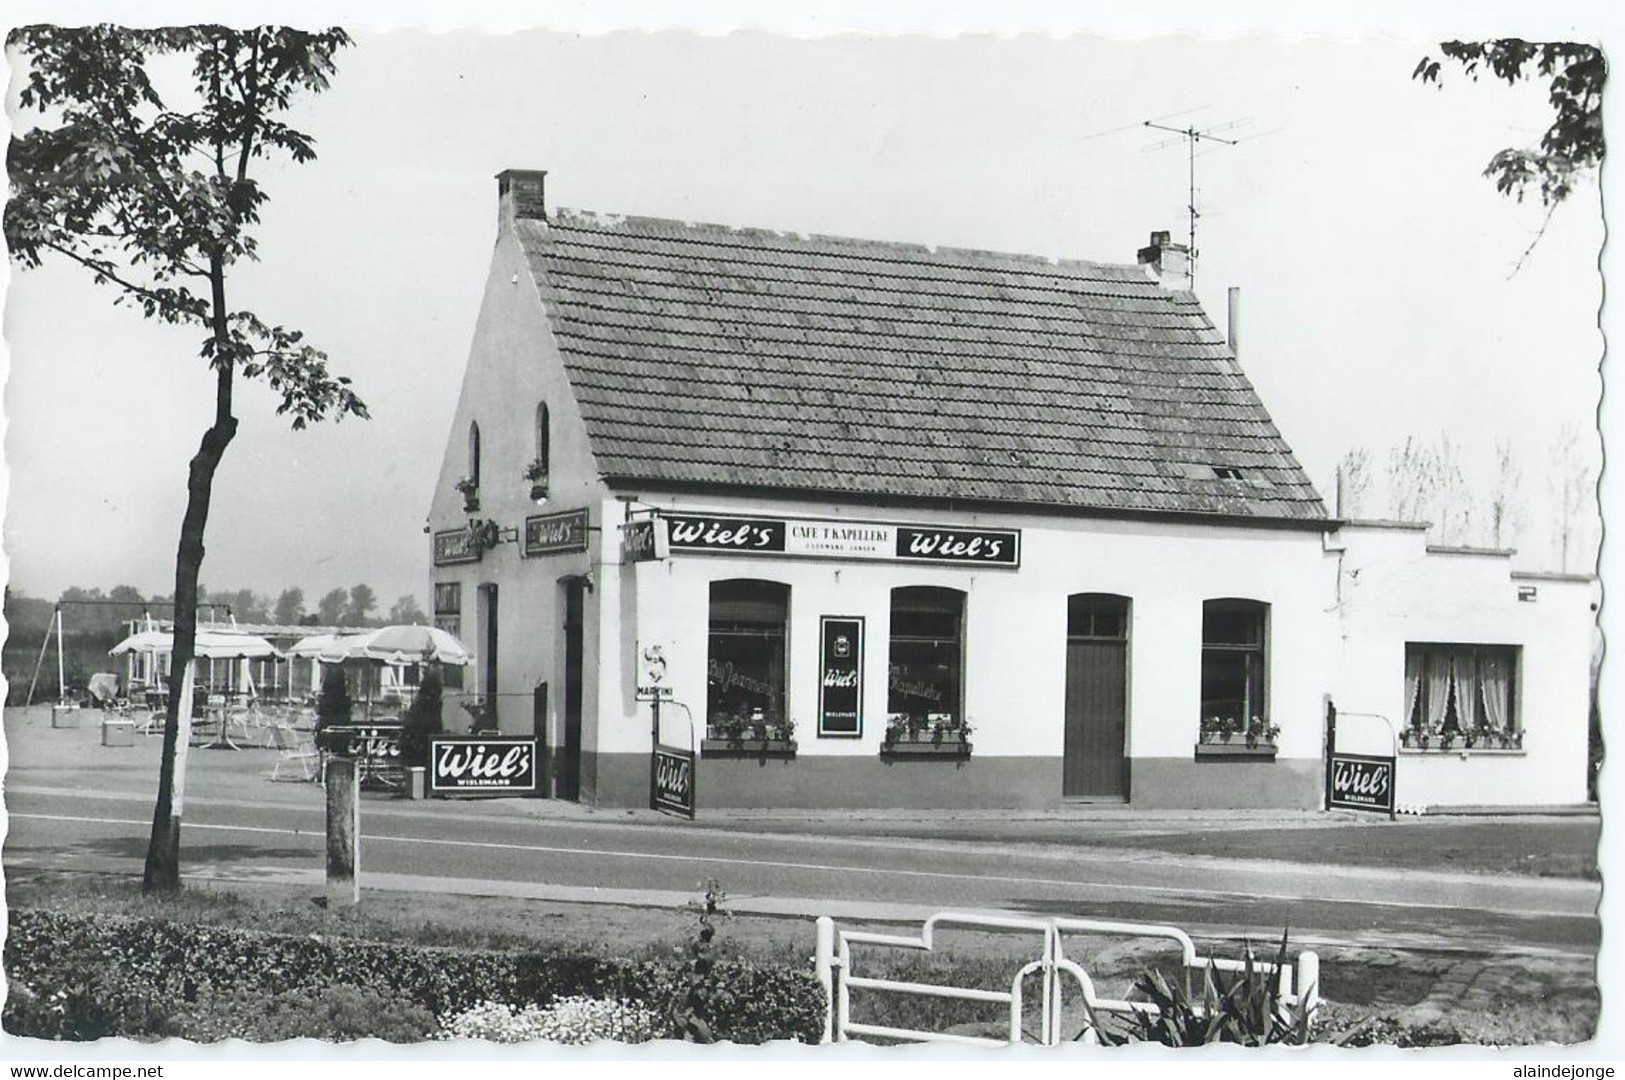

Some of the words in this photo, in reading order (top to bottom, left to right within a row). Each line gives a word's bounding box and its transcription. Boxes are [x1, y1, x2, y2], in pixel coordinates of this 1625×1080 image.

[672, 521, 773, 546] Wiel's
[909, 533, 1003, 558] Wiel's
[824, 669, 857, 687] Wiel's
[438, 745, 530, 777] Wiel's
[1334, 762, 1388, 796] Wiel's
